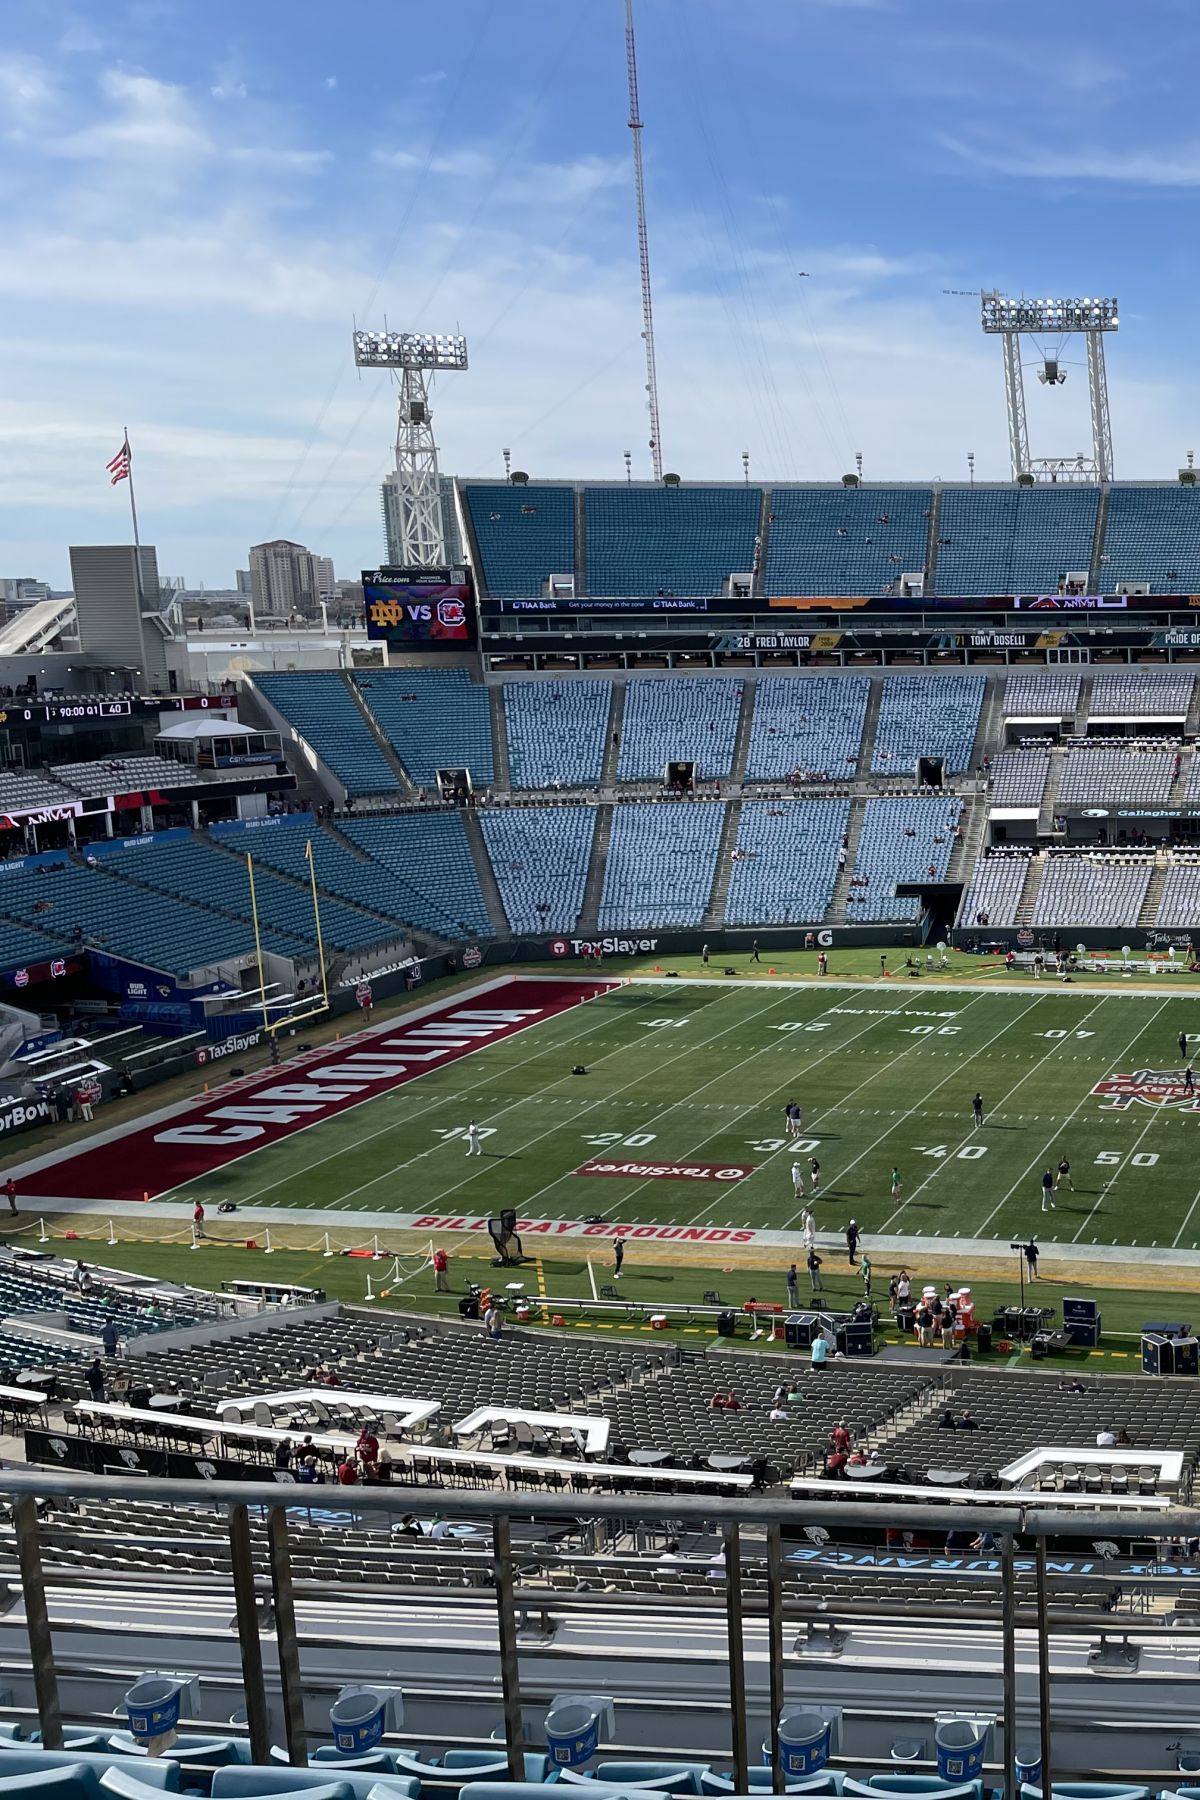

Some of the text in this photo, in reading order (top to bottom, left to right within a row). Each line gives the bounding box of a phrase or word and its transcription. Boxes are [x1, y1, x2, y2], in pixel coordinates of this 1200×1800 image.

[521, 601, 557, 609] TIAA Bank
[661, 600, 695, 608] TIAA Bank
[407, 605, 432, 620] VS
[738, 636, 810, 648] 28 FRED TAYLOR
[971, 636, 991, 646] TONY
[994, 635, 1025, 646] BOSELLI
[1165, 633, 1190, 644] PRIDE
[1191, 633, 1200, 644] OF
[201, 698, 208, 708] 0
[60, 707, 84, 717] 90:00
[86, 705, 98, 715] Q1
[109, 704, 122, 714] 40
[24, 710, 31, 720] 0
[1118, 808, 1182, 818] Gallagher
[245, 818, 281, 828] BUD LIGHT
[123, 836, 154, 848] BUD LIGHT
[5, 861, 24, 870] LIGHT
[127, 988, 147, 996] LIGHT
[777, 1022, 832, 1031] 20
[909, 1025, 962, 1035] 30
[1042, 1029, 1097, 1039] 40
[208, 1031, 261, 1060] TaxSlayer
[154, 1008, 544, 1145] CAROLINA
[586, 1133, 657, 1147] 20
[753, 1139, 821, 1153] 30
[922, 1145, 988, 1159] 40
[1093, 1151, 1160, 1167] 50
[585, 1163, 711, 1179] TaxSlayer
[410, 1216, 756, 1242] BILL GAY GROUNDS
